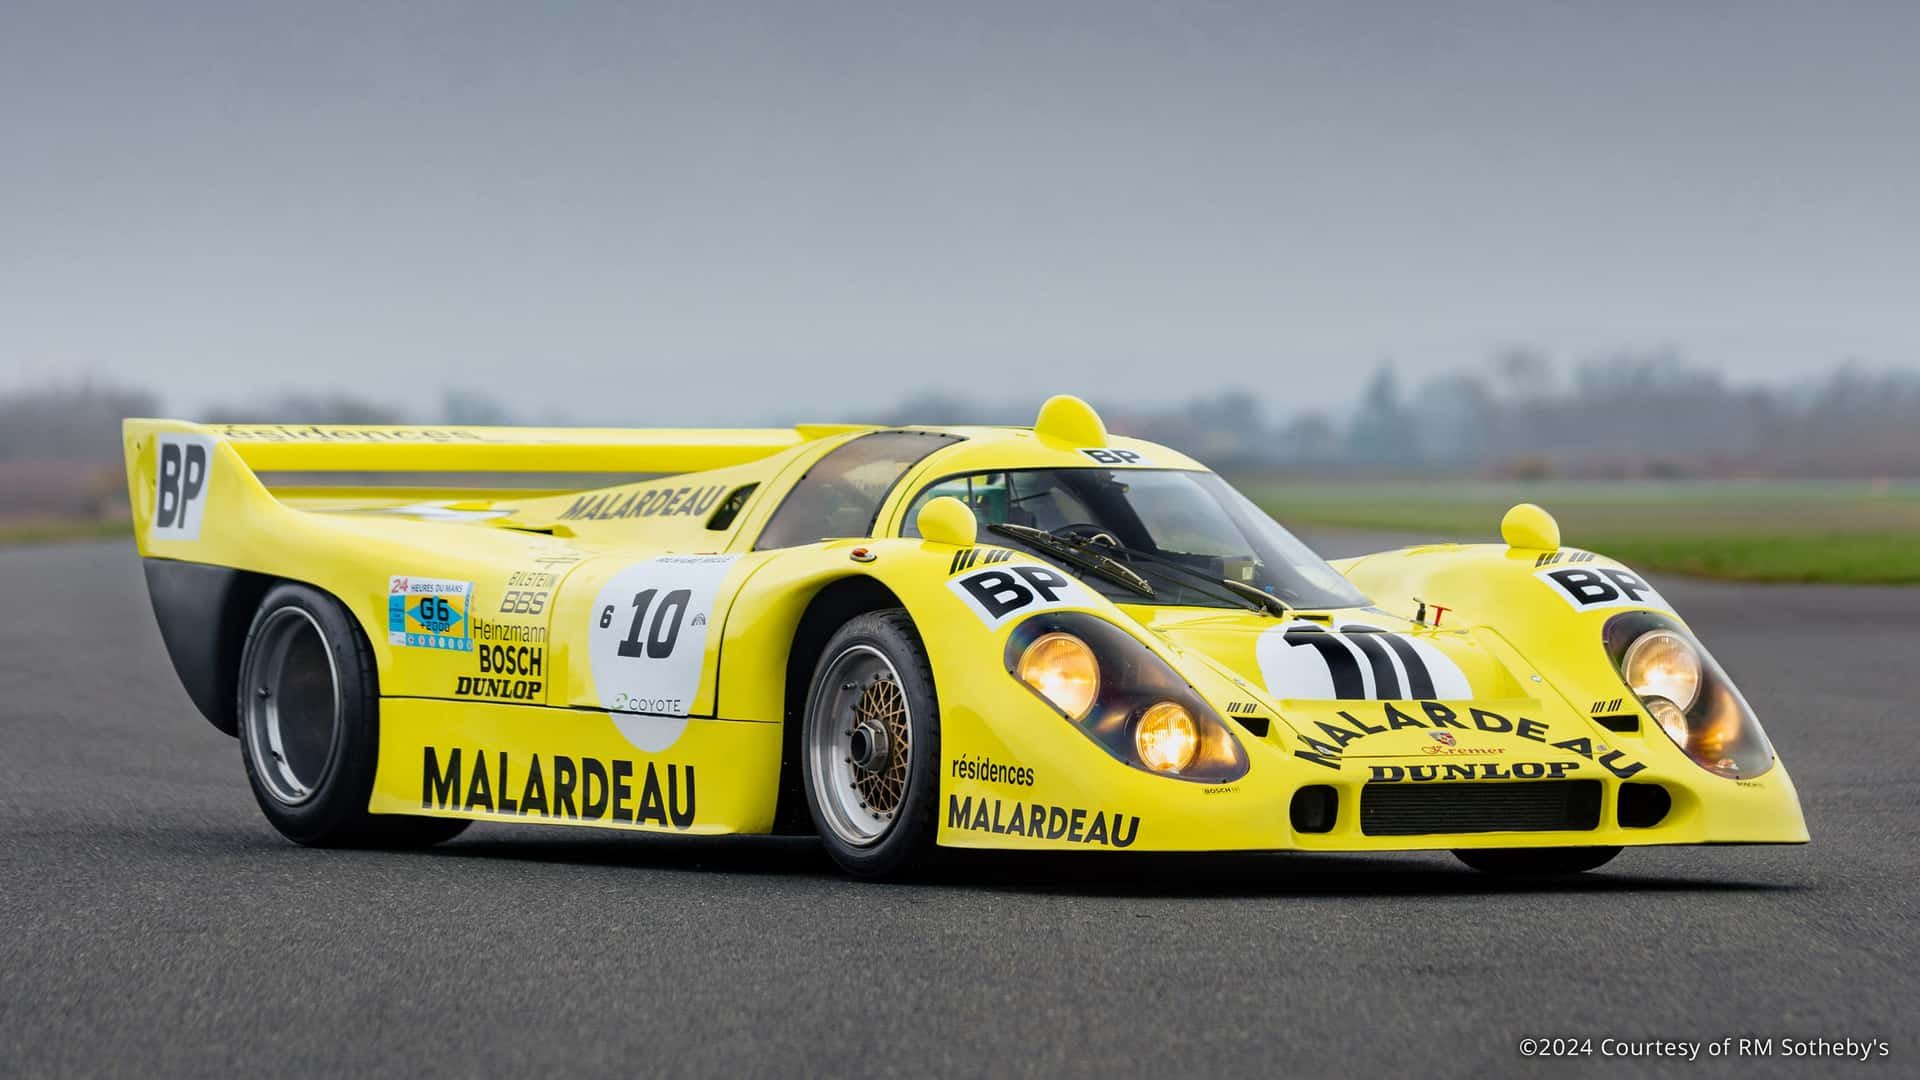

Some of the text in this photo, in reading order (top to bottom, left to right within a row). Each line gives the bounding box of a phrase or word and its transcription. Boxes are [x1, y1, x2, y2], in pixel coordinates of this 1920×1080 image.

[1082, 450, 1140, 464] BP
[156, 443, 206, 529] BP
[557, 486, 728, 521] MALARDEAU
[391, 577, 408, 594] 24
[959, 566, 1068, 620] BP
[1547, 568, 1650, 605] BP
[420, 597, 449, 621] G6
[500, 591, 547, 615] BBS
[599, 605, 615, 629] 6
[473, 617, 546, 643] Heinzmann
[617, 588, 692, 659] 10
[479, 644, 542, 676] BOSCH
[1283, 624, 1438, 700] 10
[455, 676, 542, 700] DUNLOP
[629, 698, 681, 712] COYOTE
[1294, 700, 1647, 779] MALARDEAU
[952, 753, 1034, 787] résidences
[1368, 761, 1580, 783] DUNLOP
[422, 746, 696, 831] MALARDEAU
[947, 794, 1140, 848] MALARDEAU
